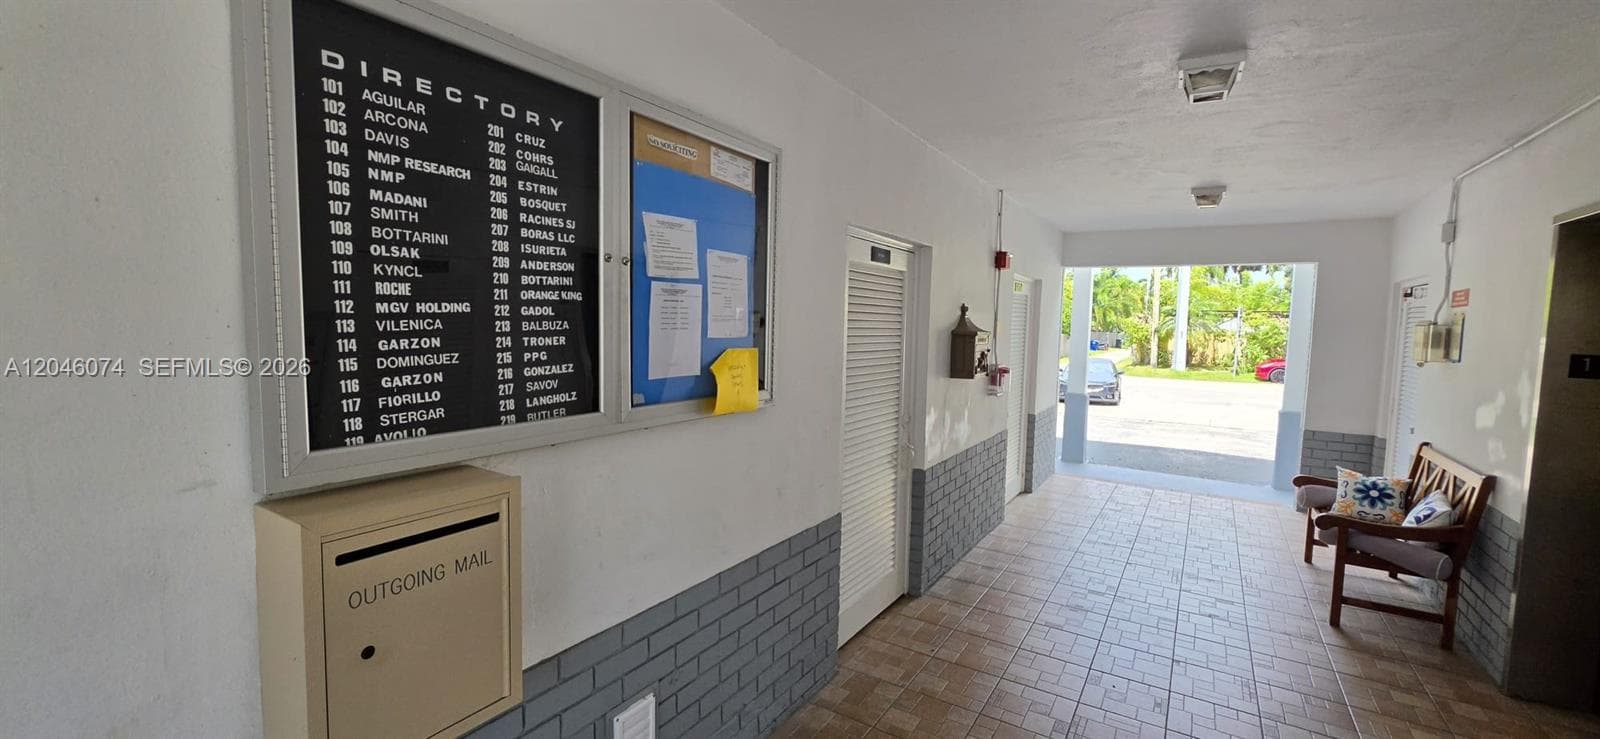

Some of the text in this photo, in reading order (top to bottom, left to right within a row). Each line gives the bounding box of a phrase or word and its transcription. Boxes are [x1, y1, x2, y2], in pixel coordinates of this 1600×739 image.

[321, 49, 563, 132] DIRECTORY
[322, 77, 426, 115] 101 AGUILAR
[322, 98, 428, 133] 102 ARCONA
[324, 119, 409, 149] 103 DAVIS
[488, 124, 545, 148] 201 CRUZ
[325, 139, 471, 180] 104 NMP RESEARCH
[488, 141, 554, 165] 202 COHRS
[327, 161, 405, 183] 105 NMP
[489, 157, 558, 179] 203 GAIGALL
[327, 180, 427, 208] 106 MADANI
[490, 174, 558, 195] 204 ESTRIN
[328, 200, 418, 222] 107 SMITH
[490, 191, 567, 212] 205 BOSQUET
[491, 207, 575, 229] 206 RACINES SJ
[329, 221, 448, 245] 108 BOTTARINI
[491, 224, 575, 243] 207 BORAS LLC
[330, 240, 420, 258] 109 OLSAK
[492, 240, 566, 256] 208 ISURIETA
[332, 261, 423, 277] 110 KYNCL
[493, 256, 574, 271] 209 ANDERSON
[333, 280, 411, 295] 111 ROCHE
[493, 273, 572, 285] 210 BOTTARINI
[494, 289, 582, 300] 211 ORANGE KING
[334, 300, 471, 313] 112 MGV HOLDING
[494, 305, 555, 316] 212 GADOL
[336, 319, 443, 333] 113 VILENICA
[495, 321, 569, 332] 213 BALBUZA
[337, 337, 440, 352] 114 GARZON
[496, 337, 565, 348] 214 TRONER
[338, 353, 459, 372] 115 DOMINGUEZ
[497, 352, 547, 364] 215 PPG
[498, 364, 574, 380] 216 GONZALEZ
[340, 372, 443, 393] 116 GARZON
[498, 380, 558, 395] 217 SAVOV
[341, 391, 441, 412] 117 FIORILLO
[500, 392, 577, 411] 218 LANGHOLZ
[343, 408, 445, 432] 118 STERGAR
[501, 415, 515, 425] 219
[348, 550, 493, 609] OUTGOING MAIL
